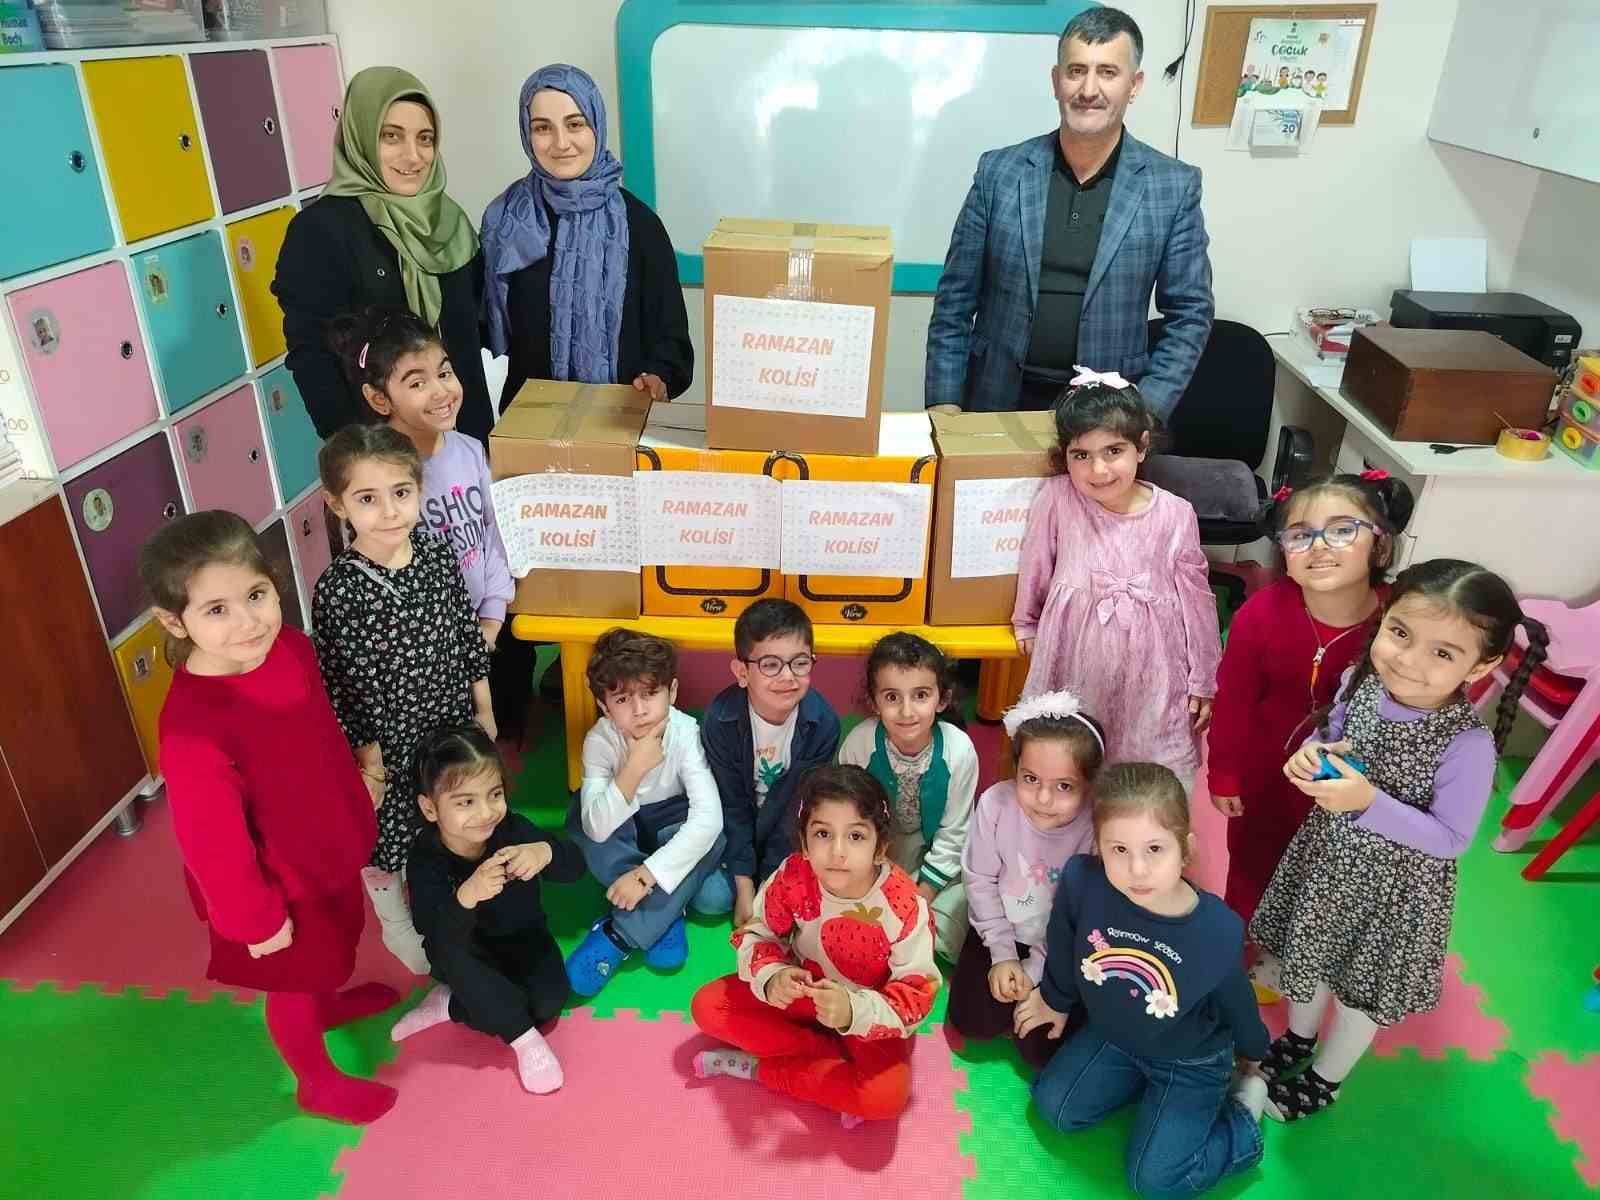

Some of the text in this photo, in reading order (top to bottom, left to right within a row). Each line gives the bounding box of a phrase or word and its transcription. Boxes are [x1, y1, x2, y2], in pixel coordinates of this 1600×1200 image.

[1282, 124, 1296, 133] 20
[742, 332, 834, 356] RAMAZAN
[758, 366, 819, 389] KOLİSİ
[415, 485, 484, 531] ASHIO
[520, 502, 608, 520] RAMAZAN
[662, 500, 748, 517] RAMAZAN
[808, 509, 895, 527] RAMAZAN
[981, 508, 1031, 525] RAMA
[540, 528, 597, 548] KOLİSİ
[679, 526, 735, 546] KOLİSİ
[824, 535, 880, 555] KOLİSİ
[1153, 941, 1182, 964] season
